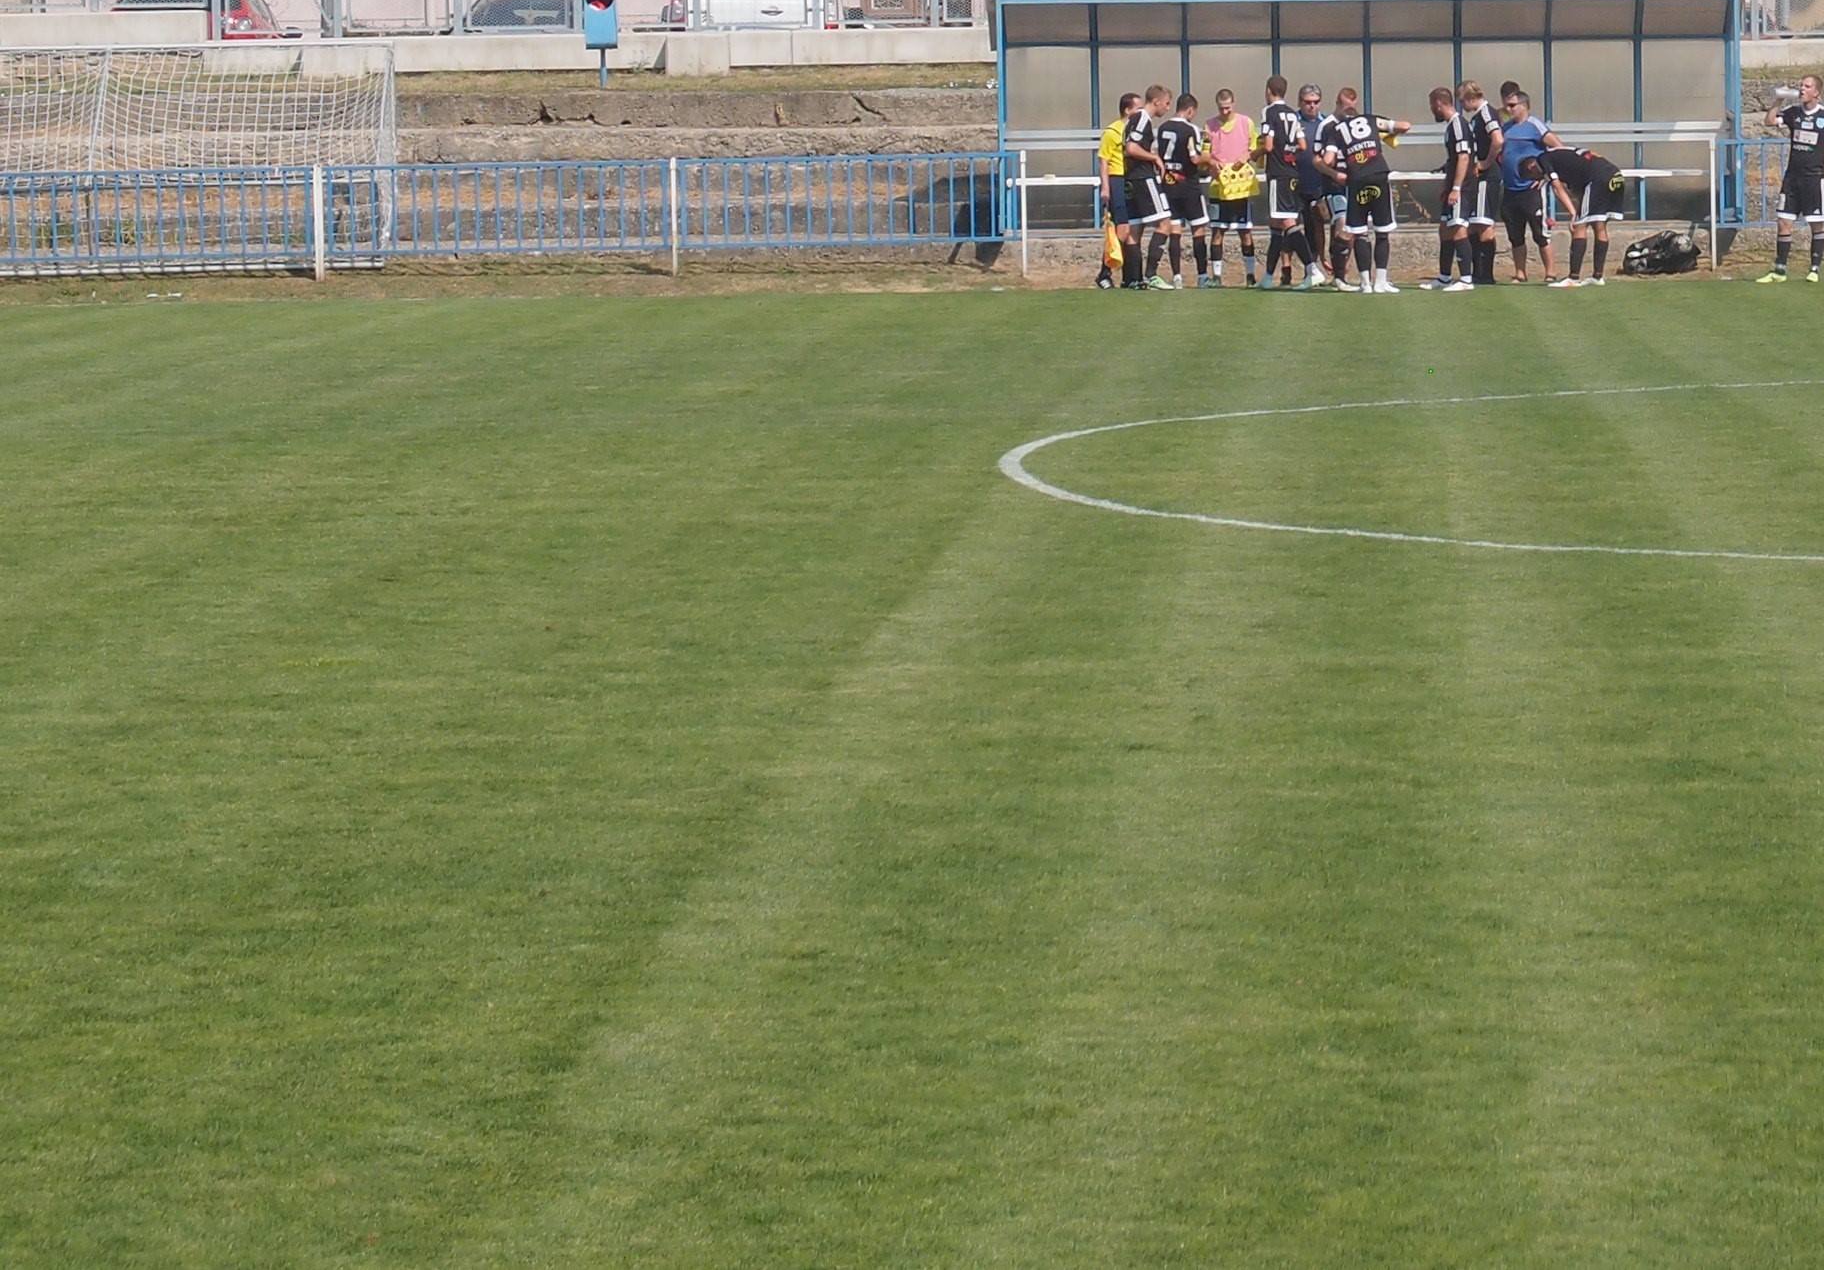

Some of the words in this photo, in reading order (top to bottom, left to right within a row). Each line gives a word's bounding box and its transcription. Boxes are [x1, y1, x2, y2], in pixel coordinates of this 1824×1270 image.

[1278, 112, 1298, 143] 17
[1335, 116, 1372, 146] 18
[1162, 130, 1177, 161] 7
